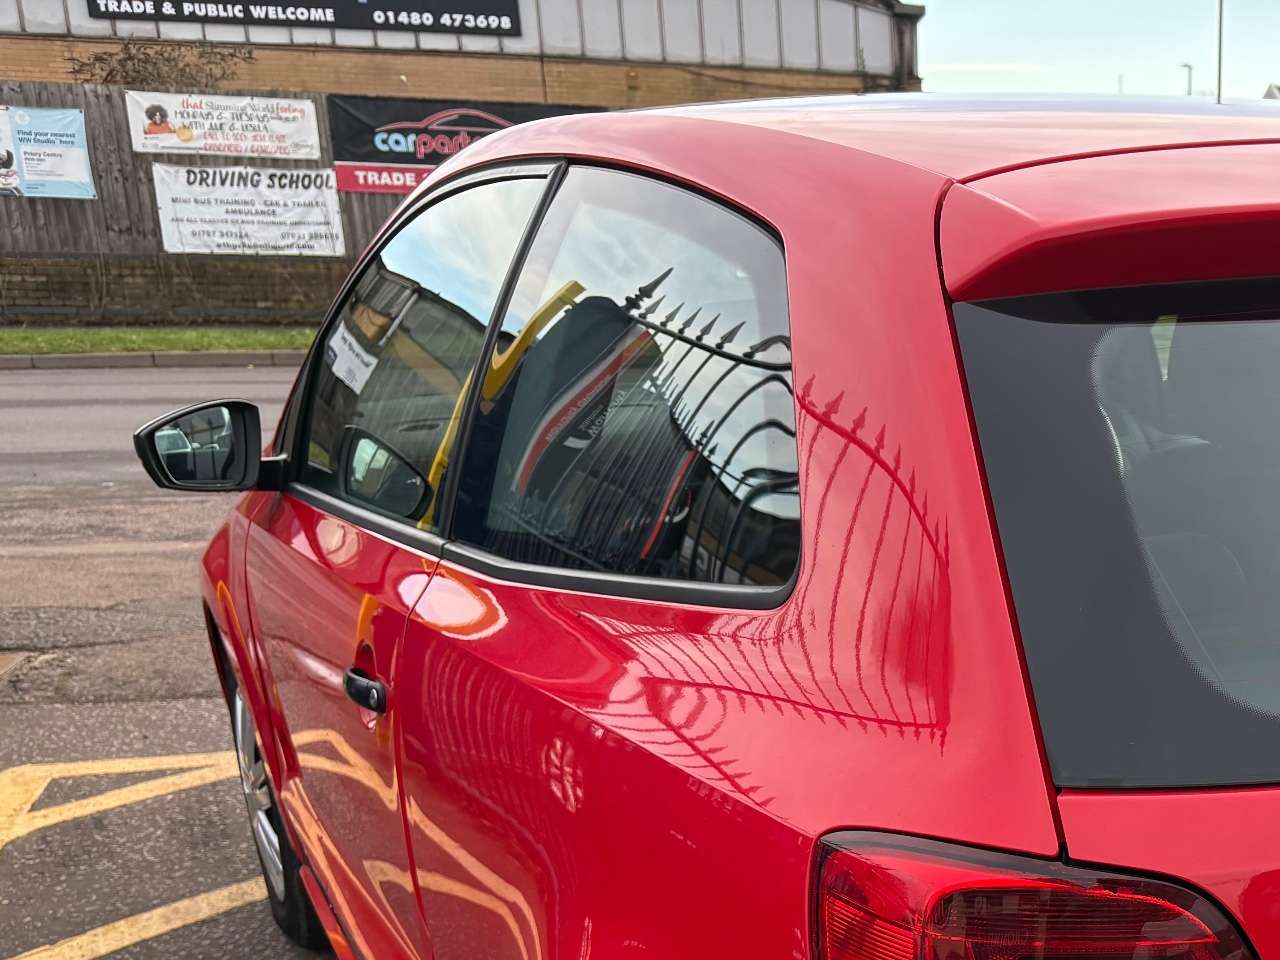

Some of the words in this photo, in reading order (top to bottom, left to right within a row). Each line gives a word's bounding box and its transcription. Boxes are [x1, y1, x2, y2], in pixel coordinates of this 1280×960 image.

[96, 0, 155, 14] TRADE
[162, 2, 176, 15] &
[182, 3, 244, 18] PUBLIC
[250, 6, 336, 22] WELCOME
[373, 10, 434, 26] 01480
[439, 13, 512, 30] 473698
[374, 131, 478, 159] carpart
[186, 169, 261, 188] DRIVING
[267, 173, 333, 190] SCHOOL
[355, 170, 417, 188] TRADE
[225, 208, 277, 217] AMBULANCE
